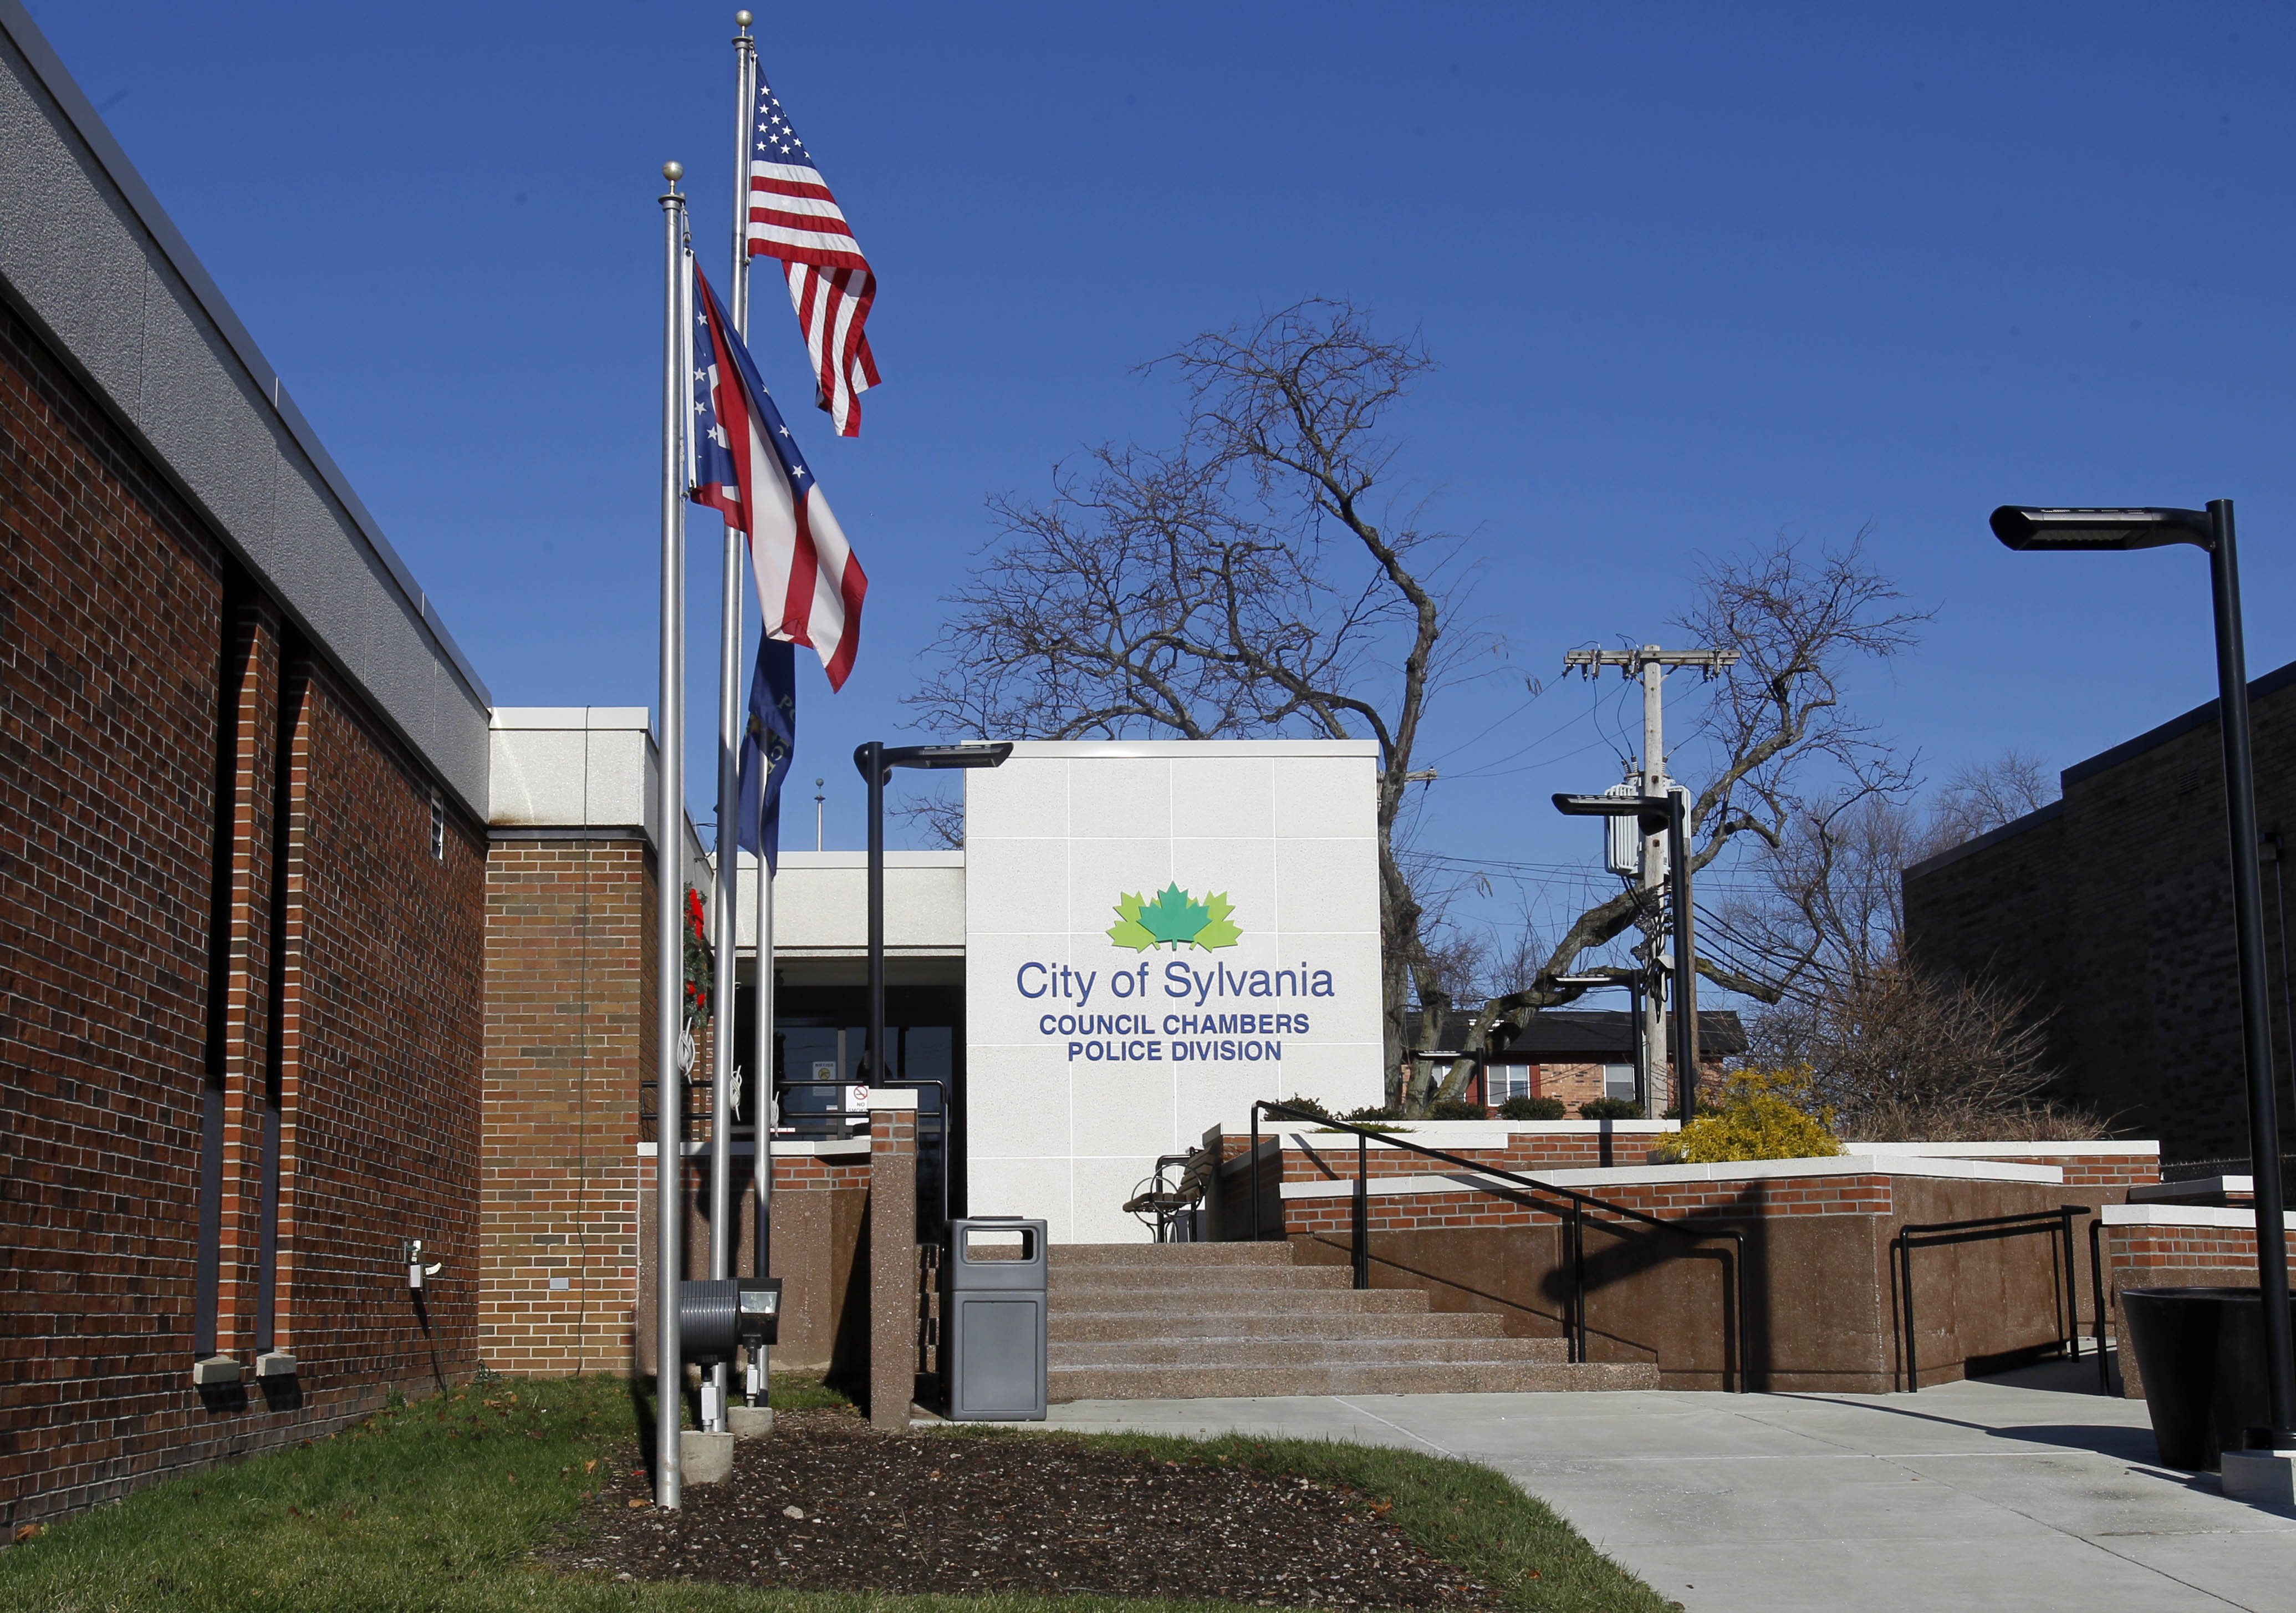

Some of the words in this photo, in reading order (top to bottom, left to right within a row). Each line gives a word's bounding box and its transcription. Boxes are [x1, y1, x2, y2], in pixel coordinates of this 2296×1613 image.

[1017, 961, 1097, 1007] City
[1111, 961, 1149, 998] of
[1165, 961, 1335, 1007] Sylvania
[1040, 1015, 1155, 1035] COUNCIL
[1163, 1014, 1309, 1035] CHAMBERS
[1068, 1041, 1162, 1061] POLICE
[1172, 1041, 1282, 1061] DIVISION
